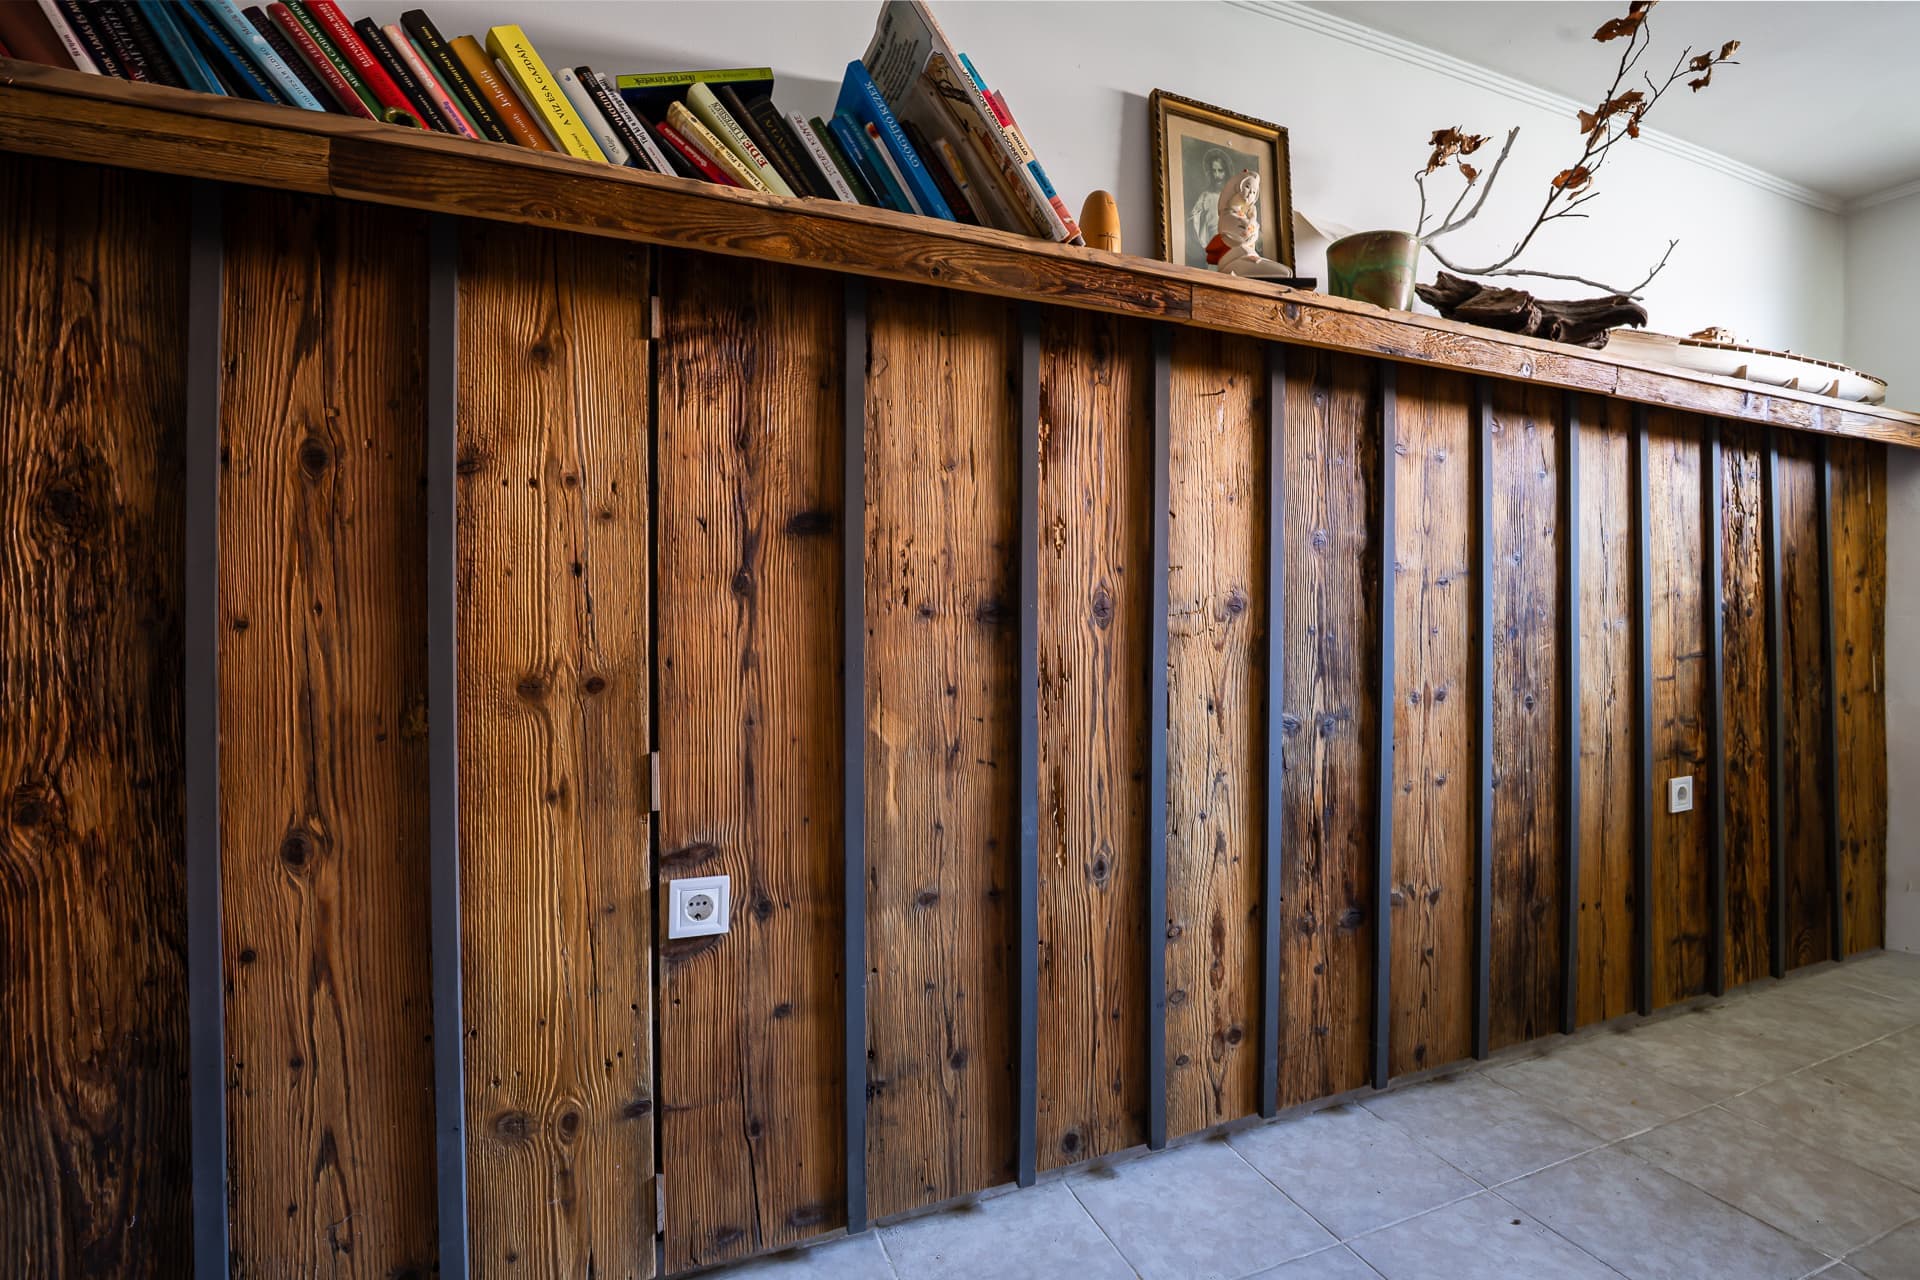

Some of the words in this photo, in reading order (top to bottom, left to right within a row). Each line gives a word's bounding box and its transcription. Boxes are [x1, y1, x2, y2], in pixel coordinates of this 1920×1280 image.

[336, 63, 362, 87] MESÉK
[511, 43, 545, 84] GAZDÁJA
[540, 92, 557, 102] ÉS
[547, 103, 568, 119] VÍZ
[595, 91, 626, 126] BUDDHA
[862, 80, 891, 116] KEZEK
[709, 102, 744, 135] LEVESBEN
[634, 132, 652, 144] Törj
[881, 116, 922, 168] GYÓGYÍTÓ
[1010, 131, 1029, 156] OTTHON
